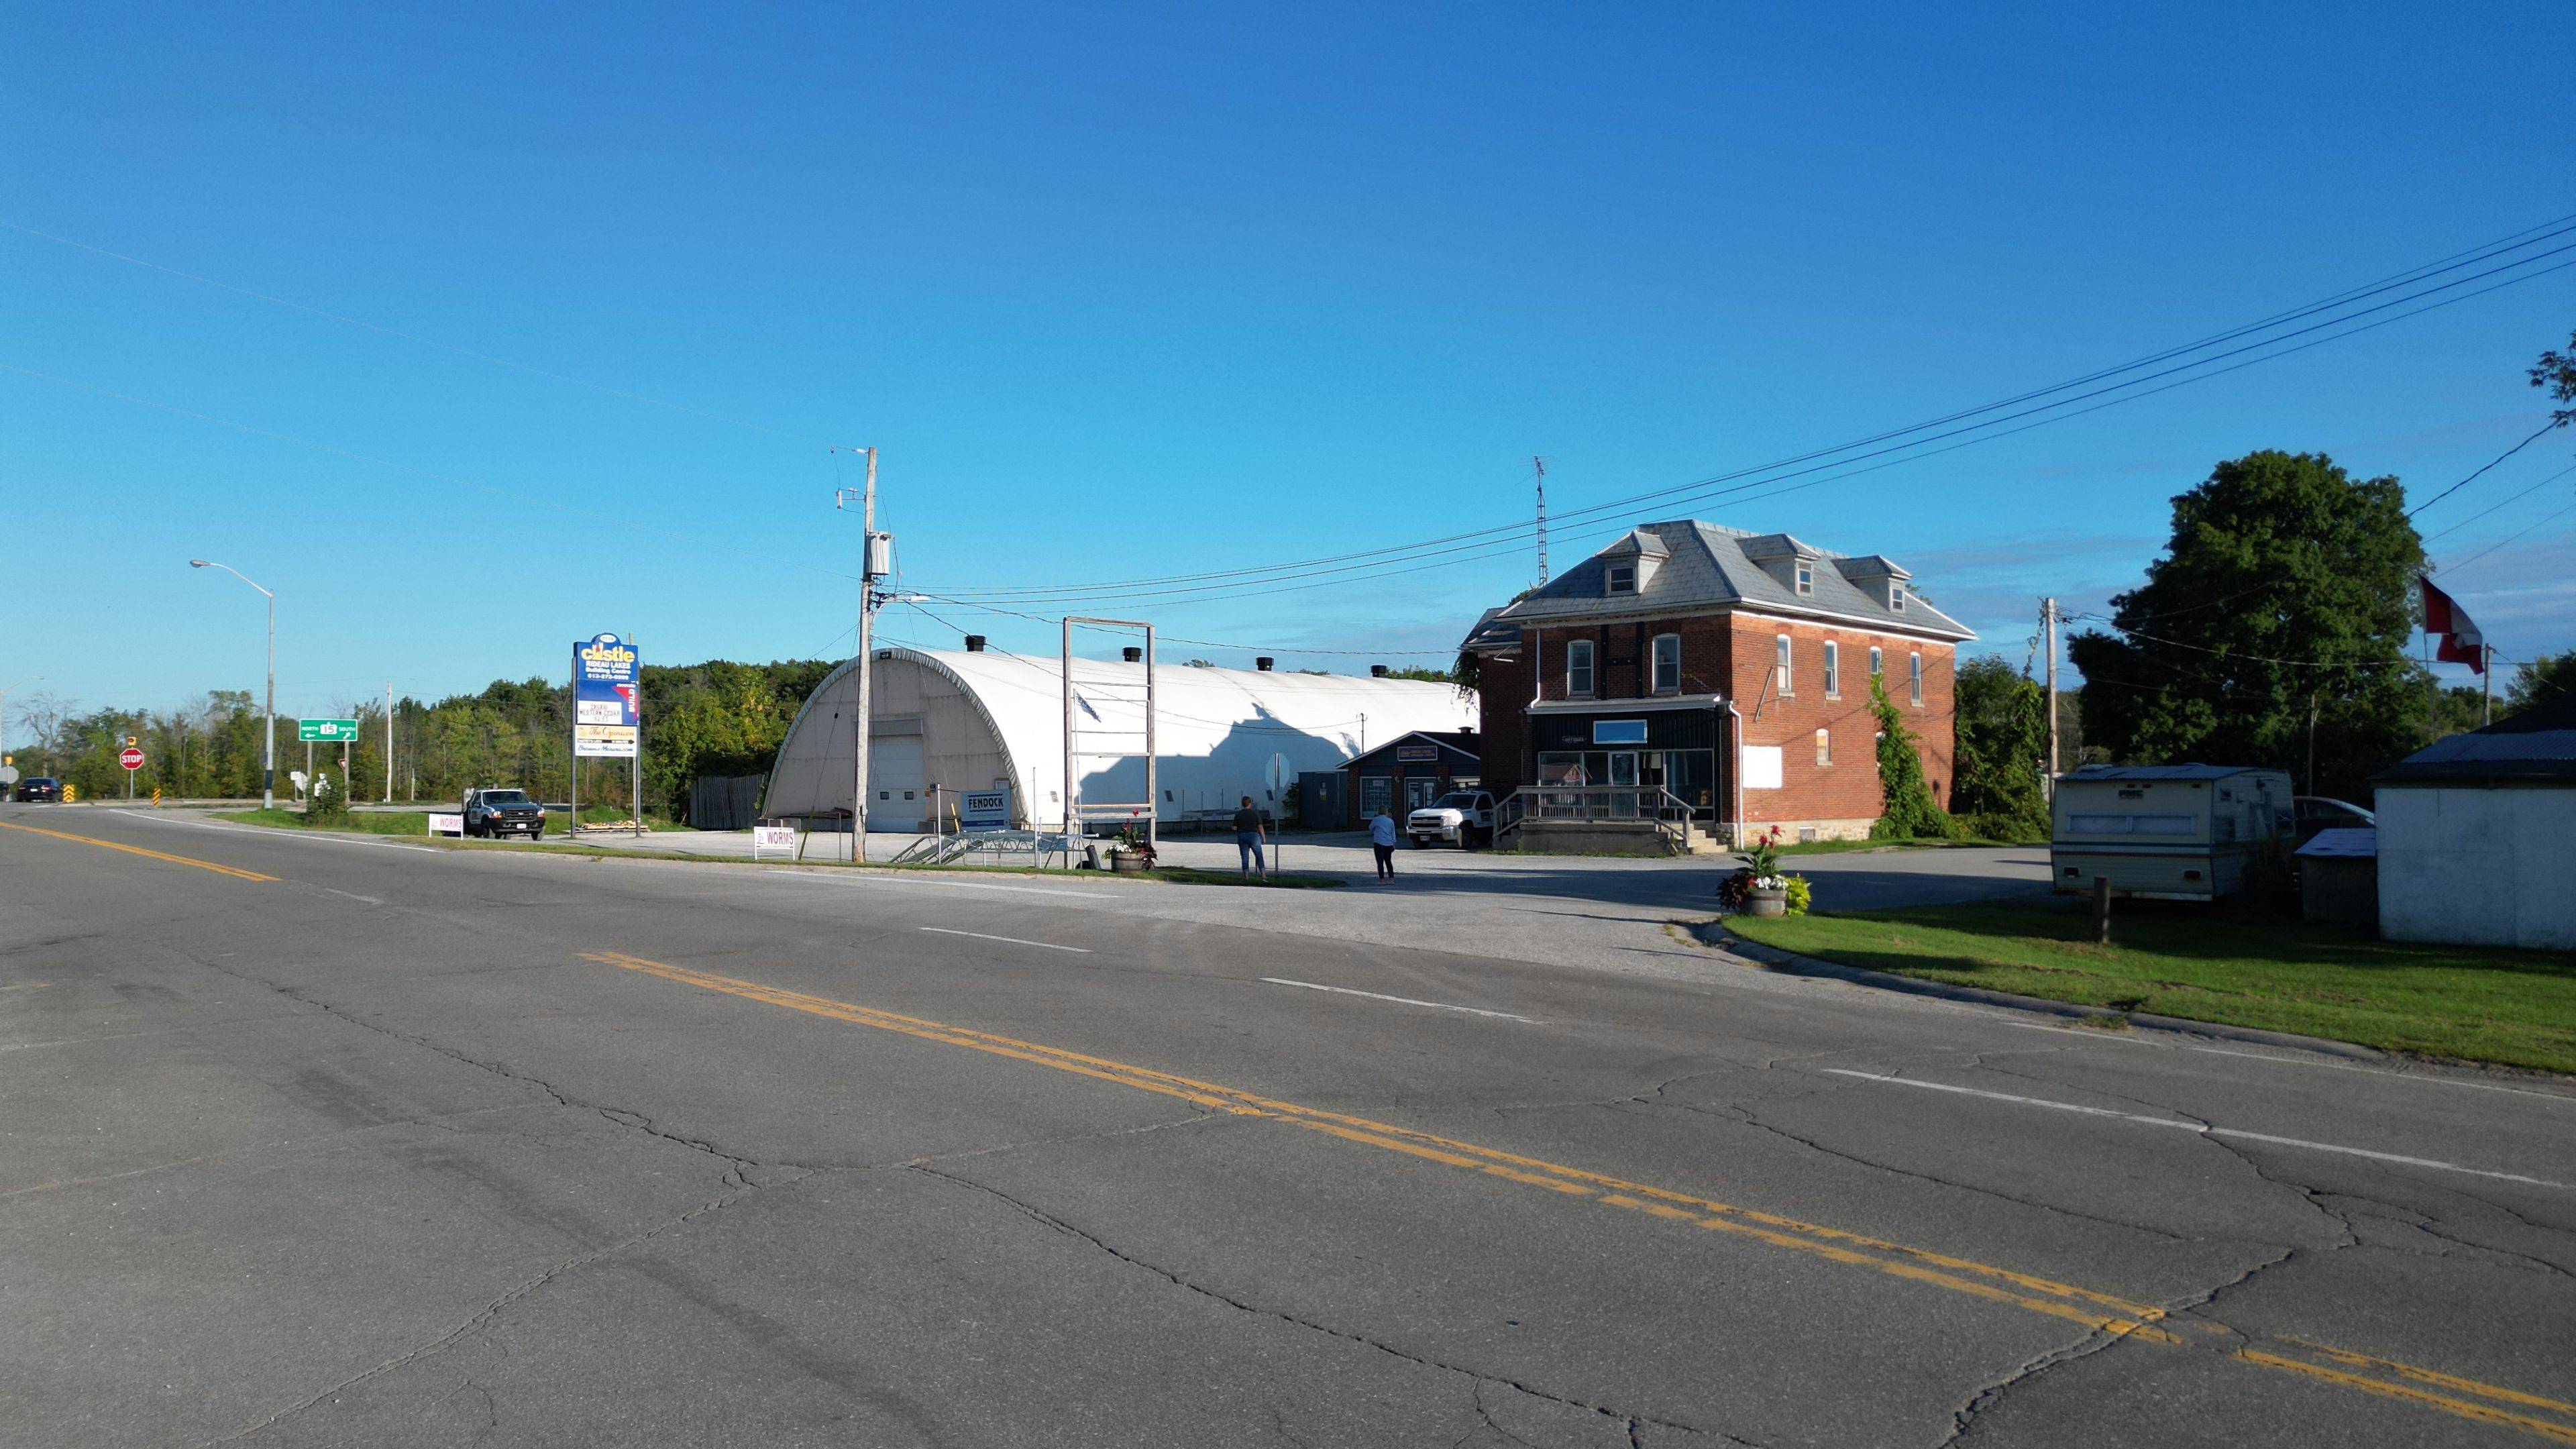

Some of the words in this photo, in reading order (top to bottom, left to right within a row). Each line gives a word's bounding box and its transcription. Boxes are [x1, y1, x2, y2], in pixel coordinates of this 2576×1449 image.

[121, 755, 142, 763] STOP
[2118, 790, 2143, 798] PMC
[968, 797, 1004, 809] FENDOCK
[439, 818, 462, 828] WORMS
[767, 831, 794, 845] WORMS
